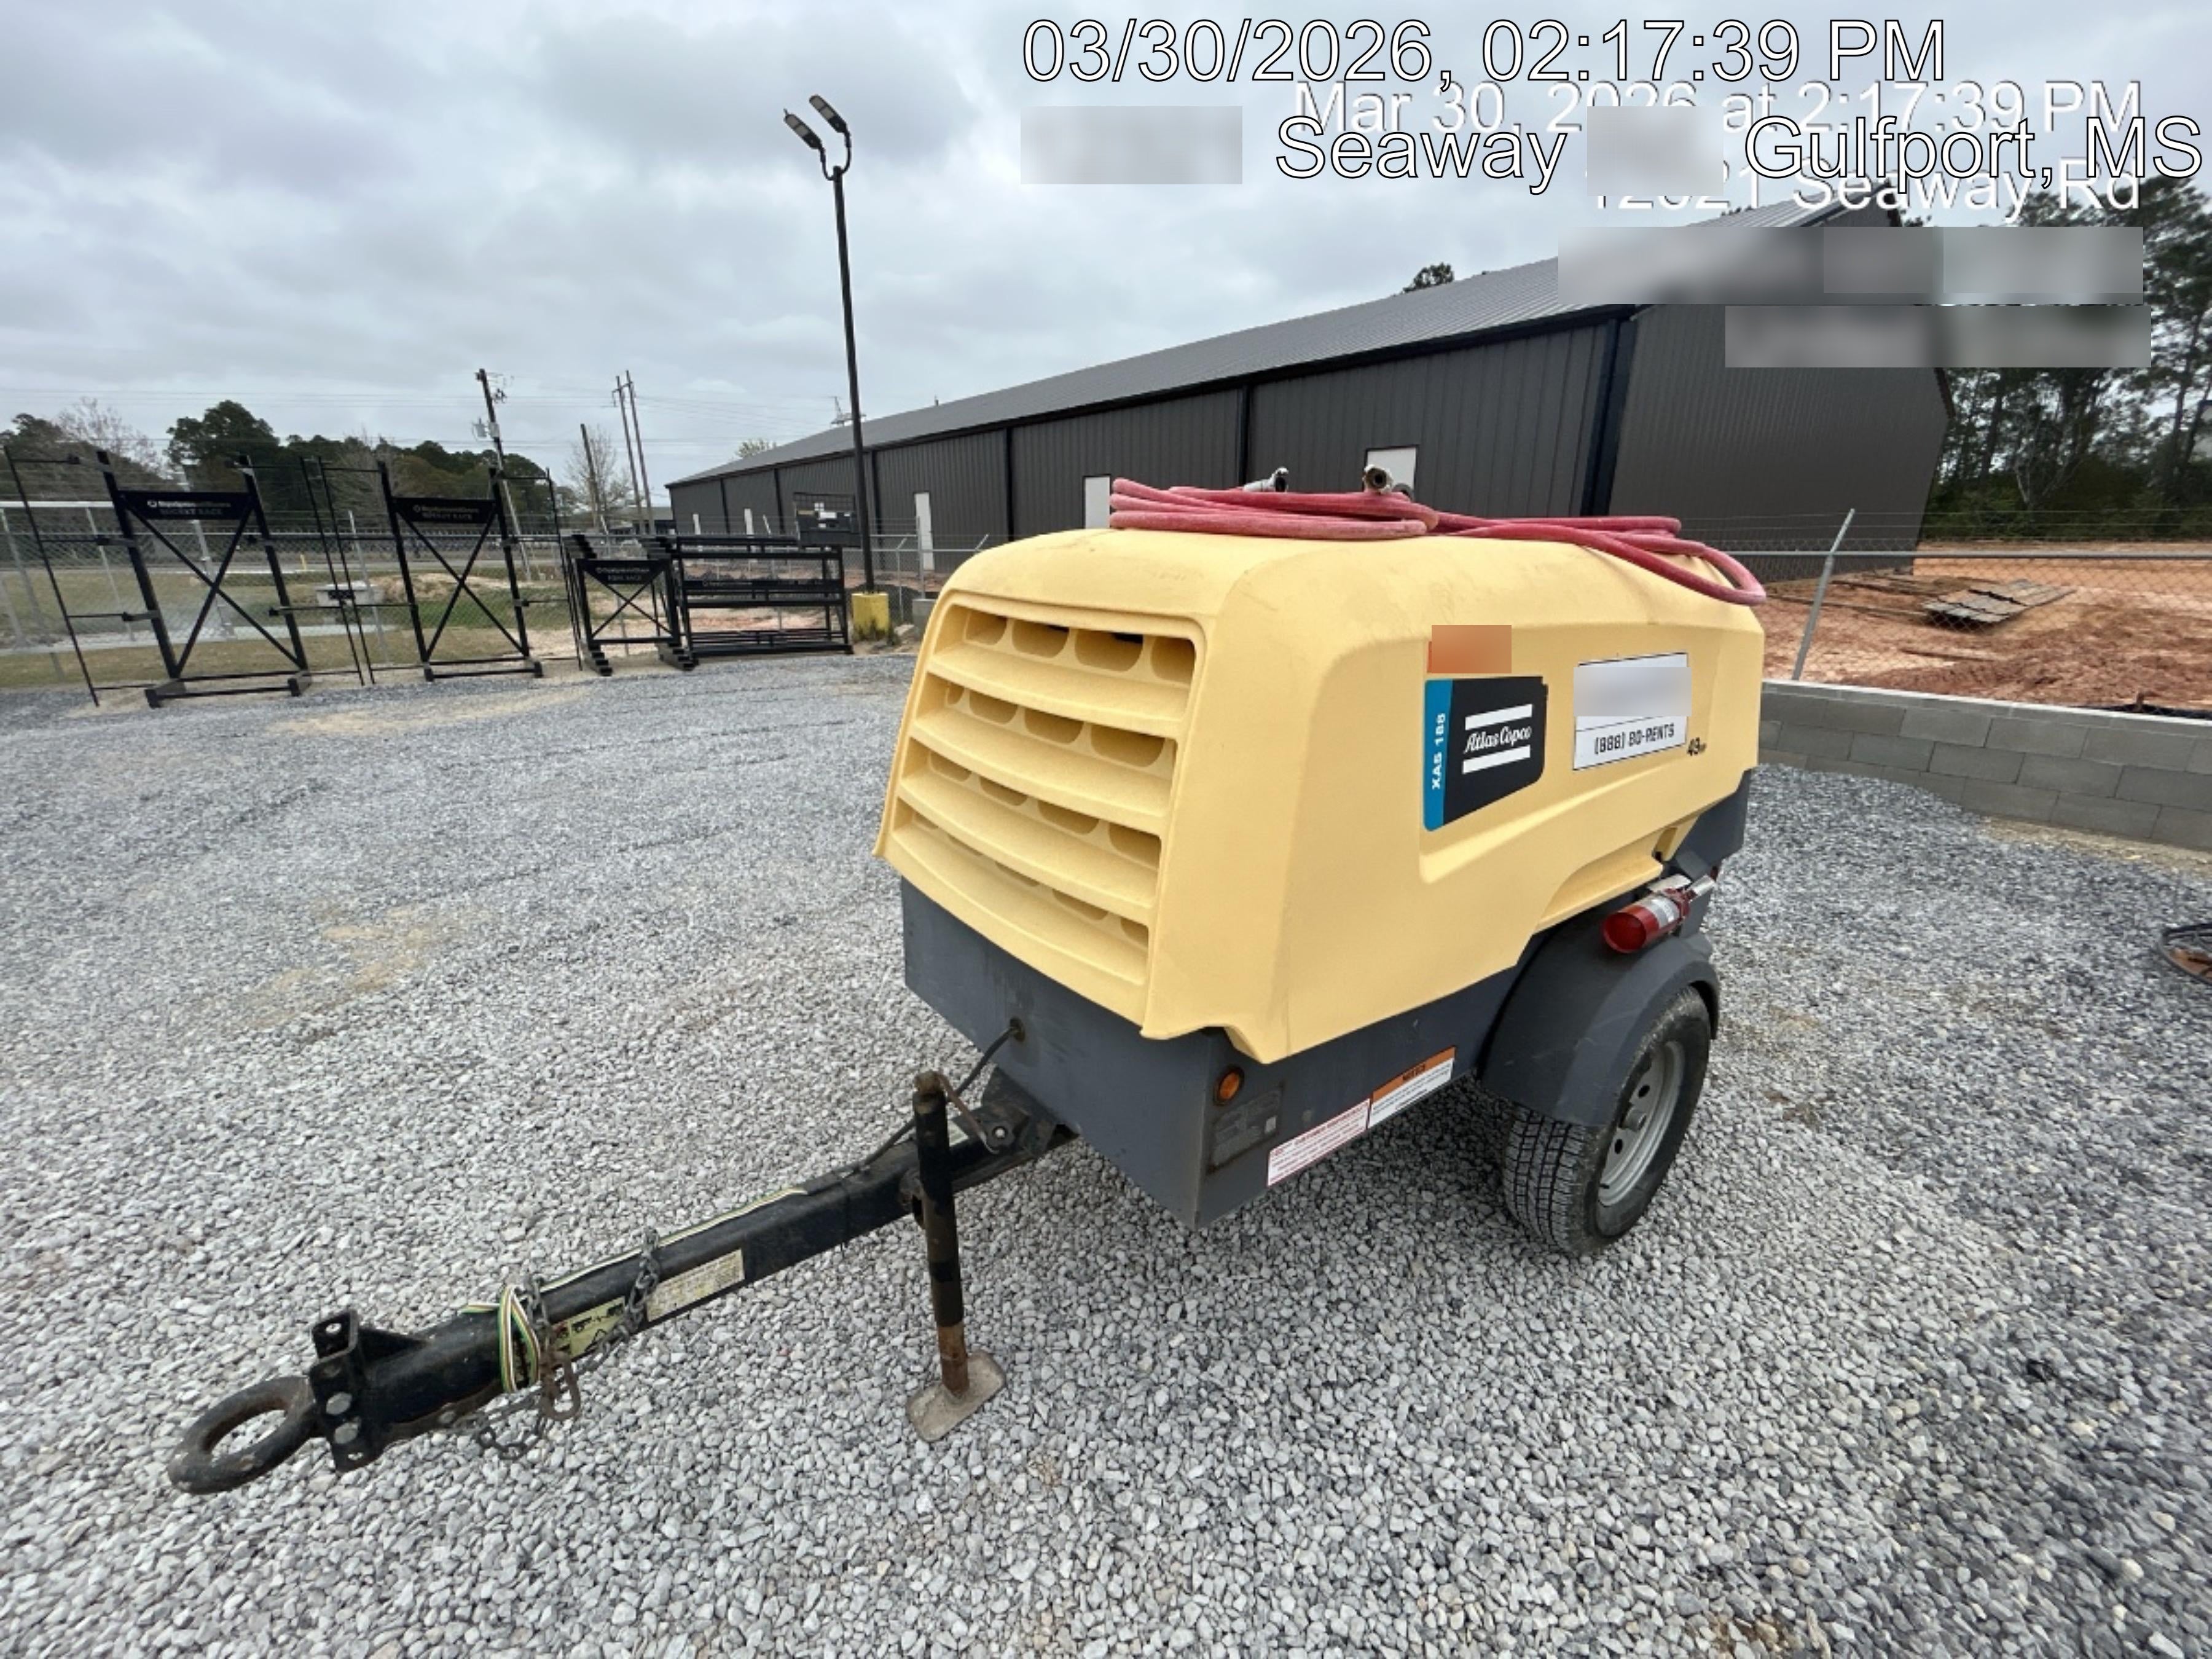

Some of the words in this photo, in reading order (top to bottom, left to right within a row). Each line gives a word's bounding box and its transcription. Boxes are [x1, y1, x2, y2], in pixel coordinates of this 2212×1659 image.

[1463, 731, 1499, 755] Atlas
[1499, 726, 1532, 747] Copco
[1431, 751, 1443, 790] XAS
